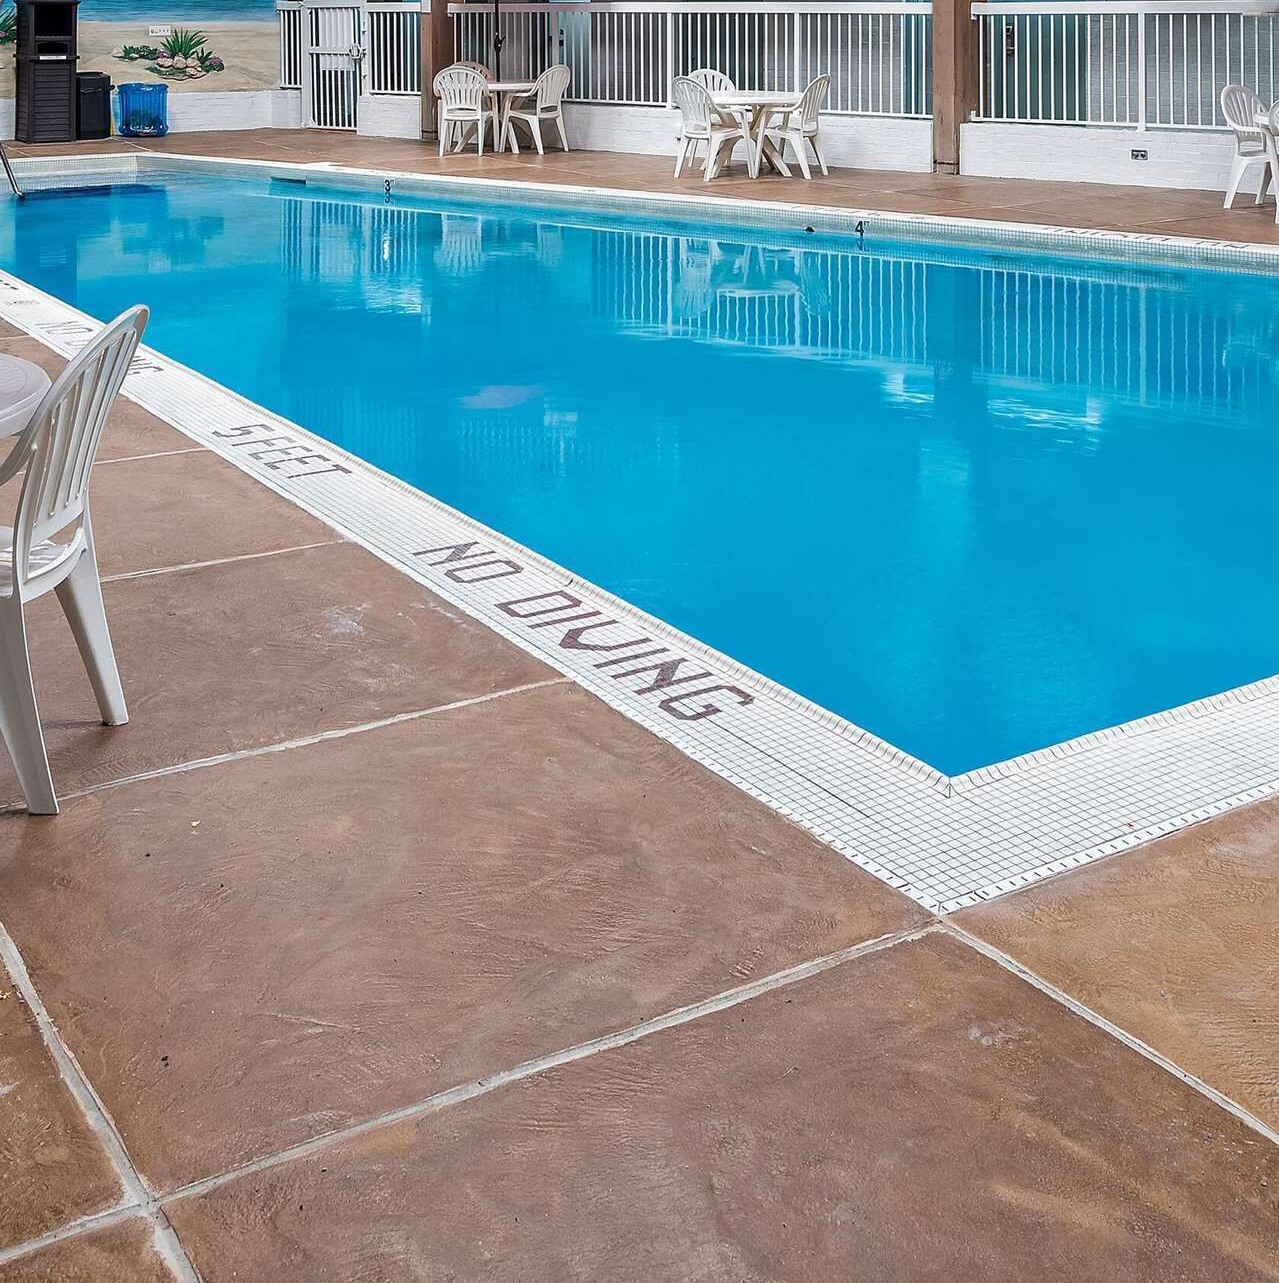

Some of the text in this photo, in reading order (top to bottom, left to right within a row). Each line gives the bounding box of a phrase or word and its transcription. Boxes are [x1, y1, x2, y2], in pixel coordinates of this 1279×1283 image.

[384, 179, 391, 192] 3
[855, 220, 864, 236] 4
[231, 436, 353, 479] FEET
[412, 541, 755, 721] NO DIVING
